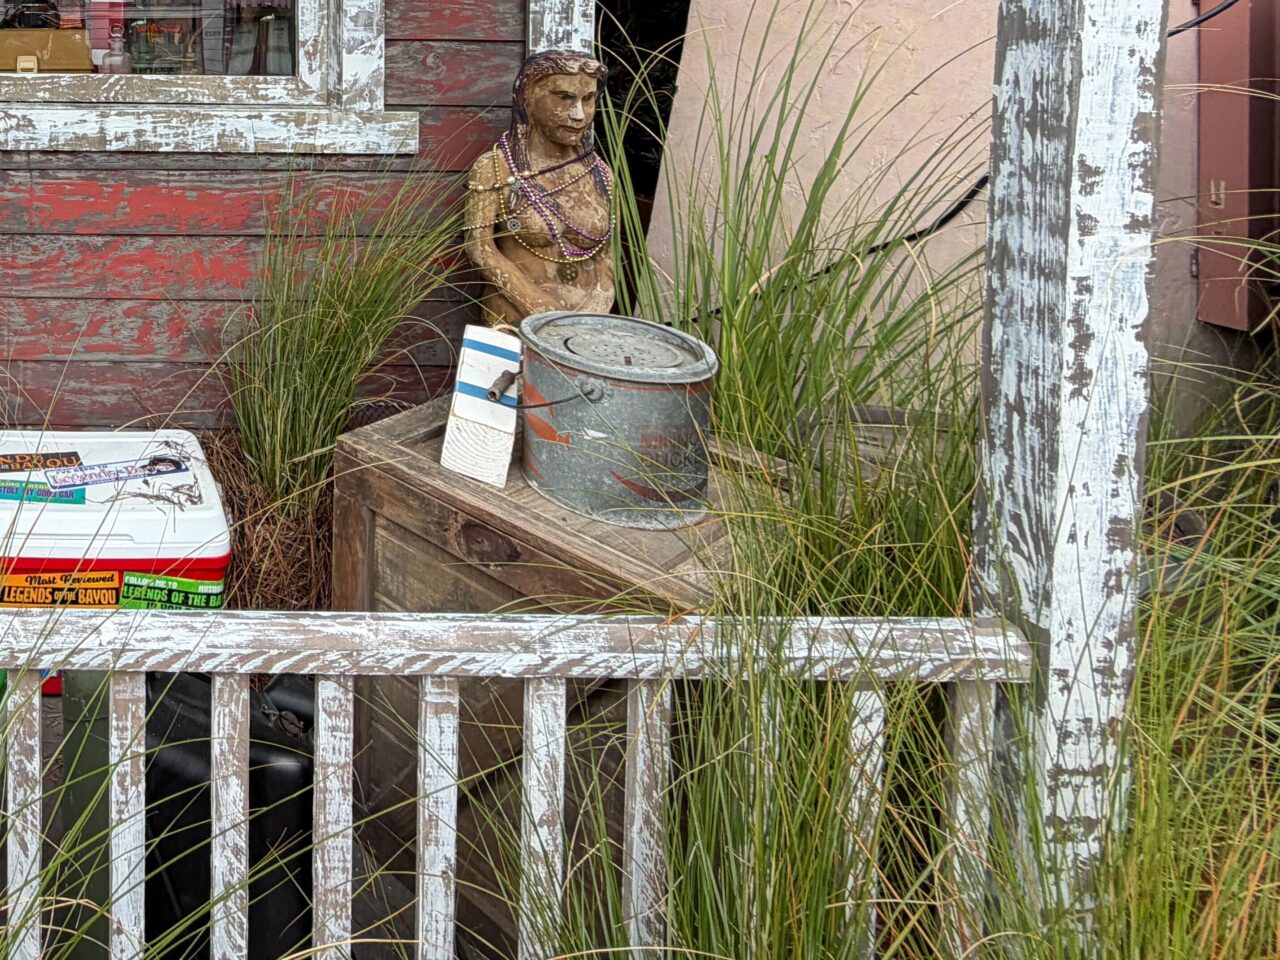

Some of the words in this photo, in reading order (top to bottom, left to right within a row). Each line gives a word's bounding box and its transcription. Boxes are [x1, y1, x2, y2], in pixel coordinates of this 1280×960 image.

[11, 456, 78, 470] BAYOU
[25, 574, 57, 586] Most
[168, 581, 178, 590] TO
[4, 587, 52, 604] LEGENDS
[78, 588, 116, 604] BAYOU
[123, 585, 168, 602] LEGENDS
[171, 591, 185, 604] OF
[188, 593, 208, 607] THE
